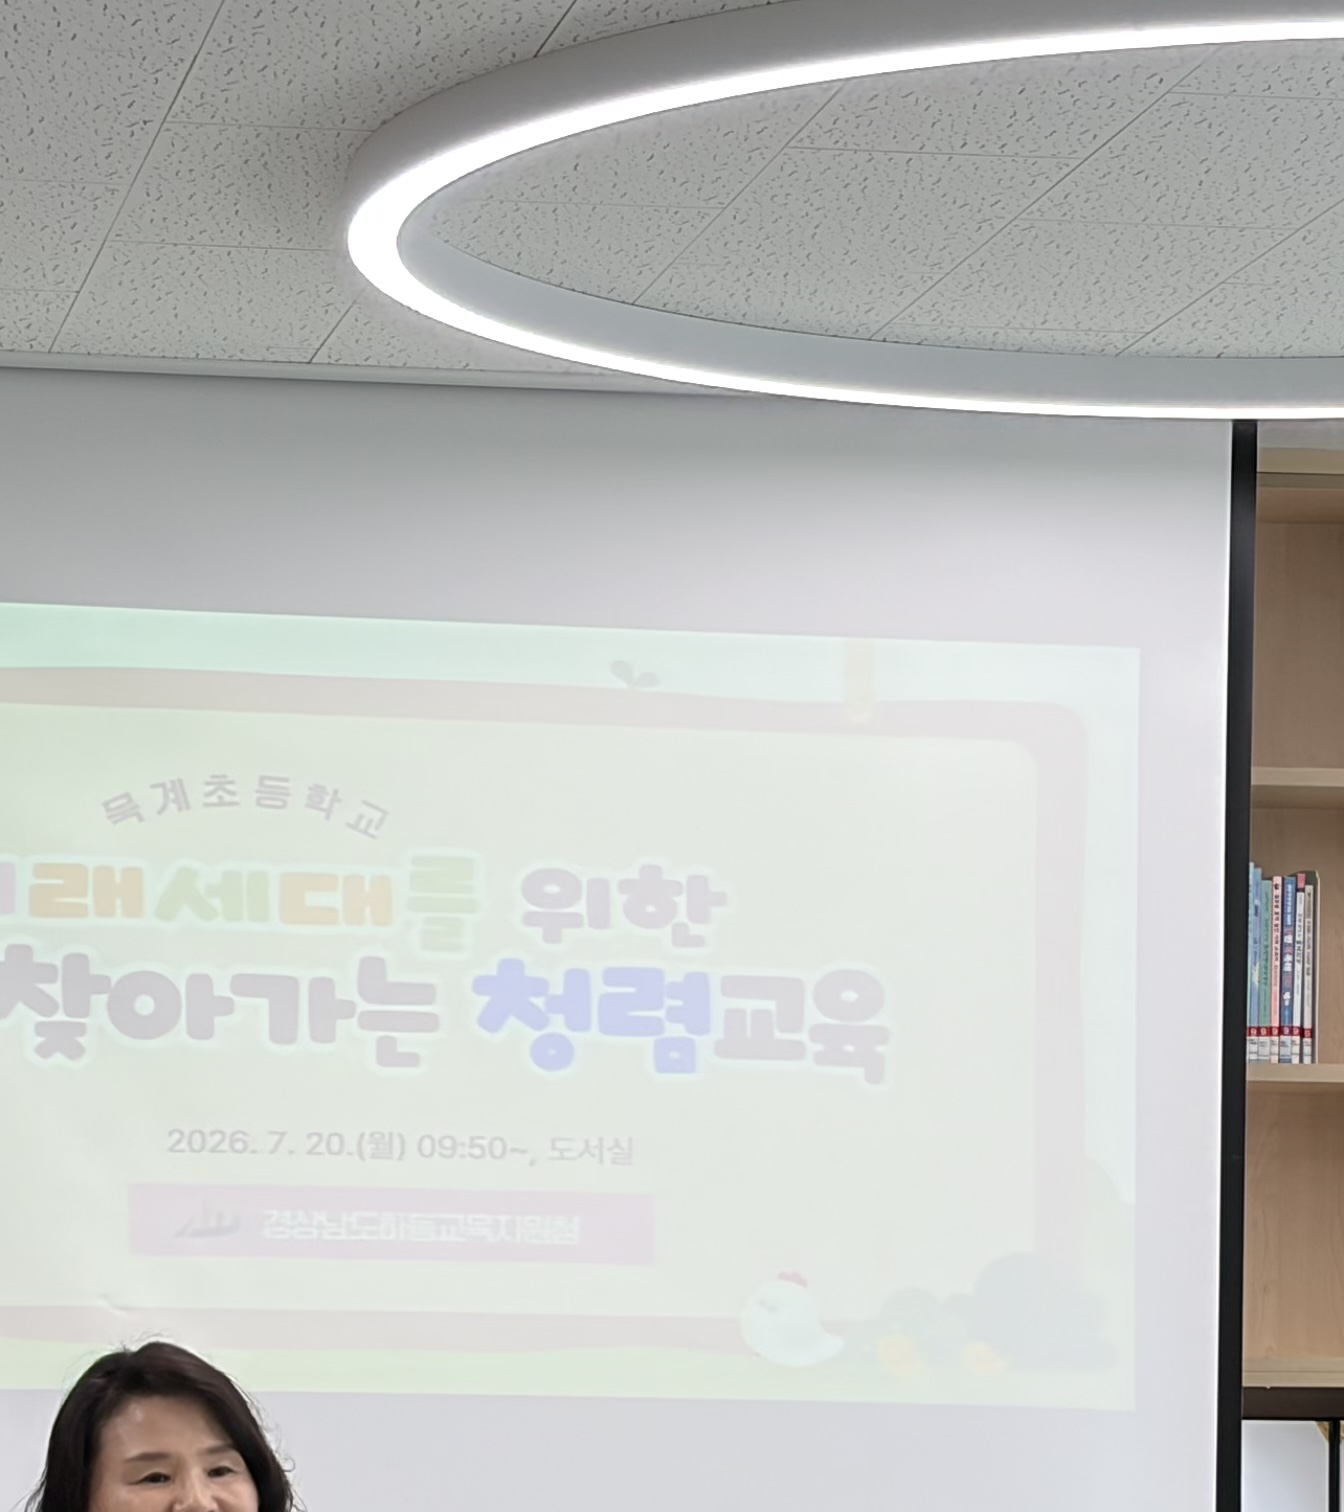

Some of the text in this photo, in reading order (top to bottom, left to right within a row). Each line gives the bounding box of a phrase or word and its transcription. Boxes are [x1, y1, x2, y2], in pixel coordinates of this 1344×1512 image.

[521, 863, 728, 948] 위한
[472, 957, 891, 1085] 청렴교육
[267, 1131, 296, 1156] 7.
[548, 1136, 634, 1167] 도서실
